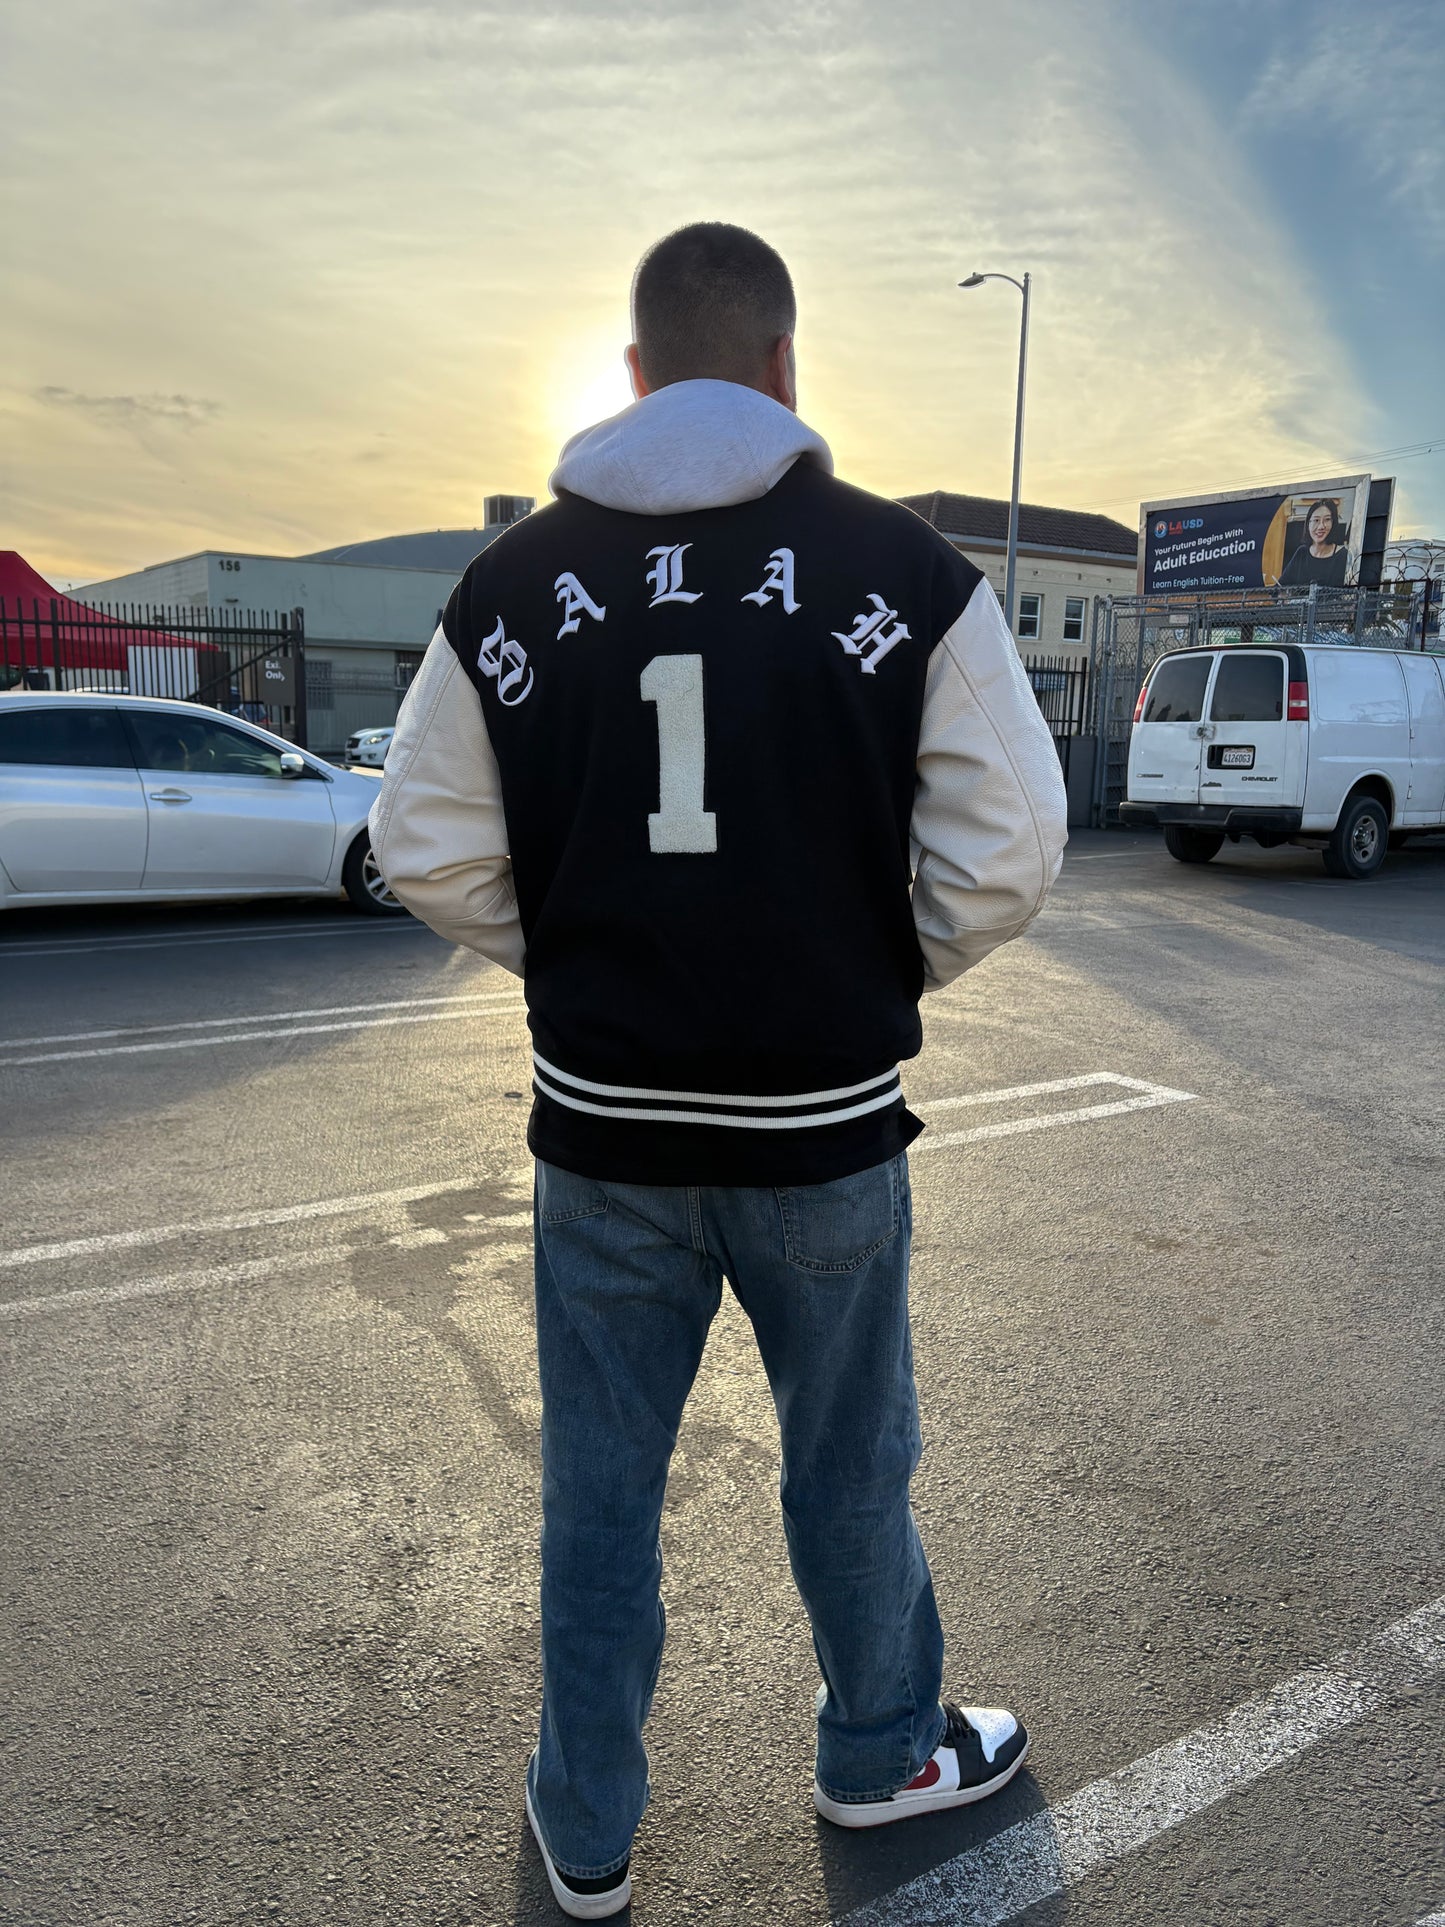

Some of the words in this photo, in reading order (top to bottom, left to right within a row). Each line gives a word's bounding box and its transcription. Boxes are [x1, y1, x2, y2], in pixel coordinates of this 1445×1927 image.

[1168, 518, 1204, 531] LAUSD
[1154, 546, 1171, 556] Your
[1172, 540, 1196, 552] Future
[1197, 533, 1224, 546] Begins
[1224, 528, 1244, 539] With
[218, 559, 241, 572] 156
[1153, 553, 1188, 573] Adult
[1189, 539, 1256, 565] Education
[1152, 580, 1173, 589] Learn
[1173, 576, 1199, 589] English
[1200, 574, 1245, 586] Tuition-Free
[476, 542, 913, 707] SALAH
[265, 660, 281, 670] Exi
[640, 653, 718, 854] 1
